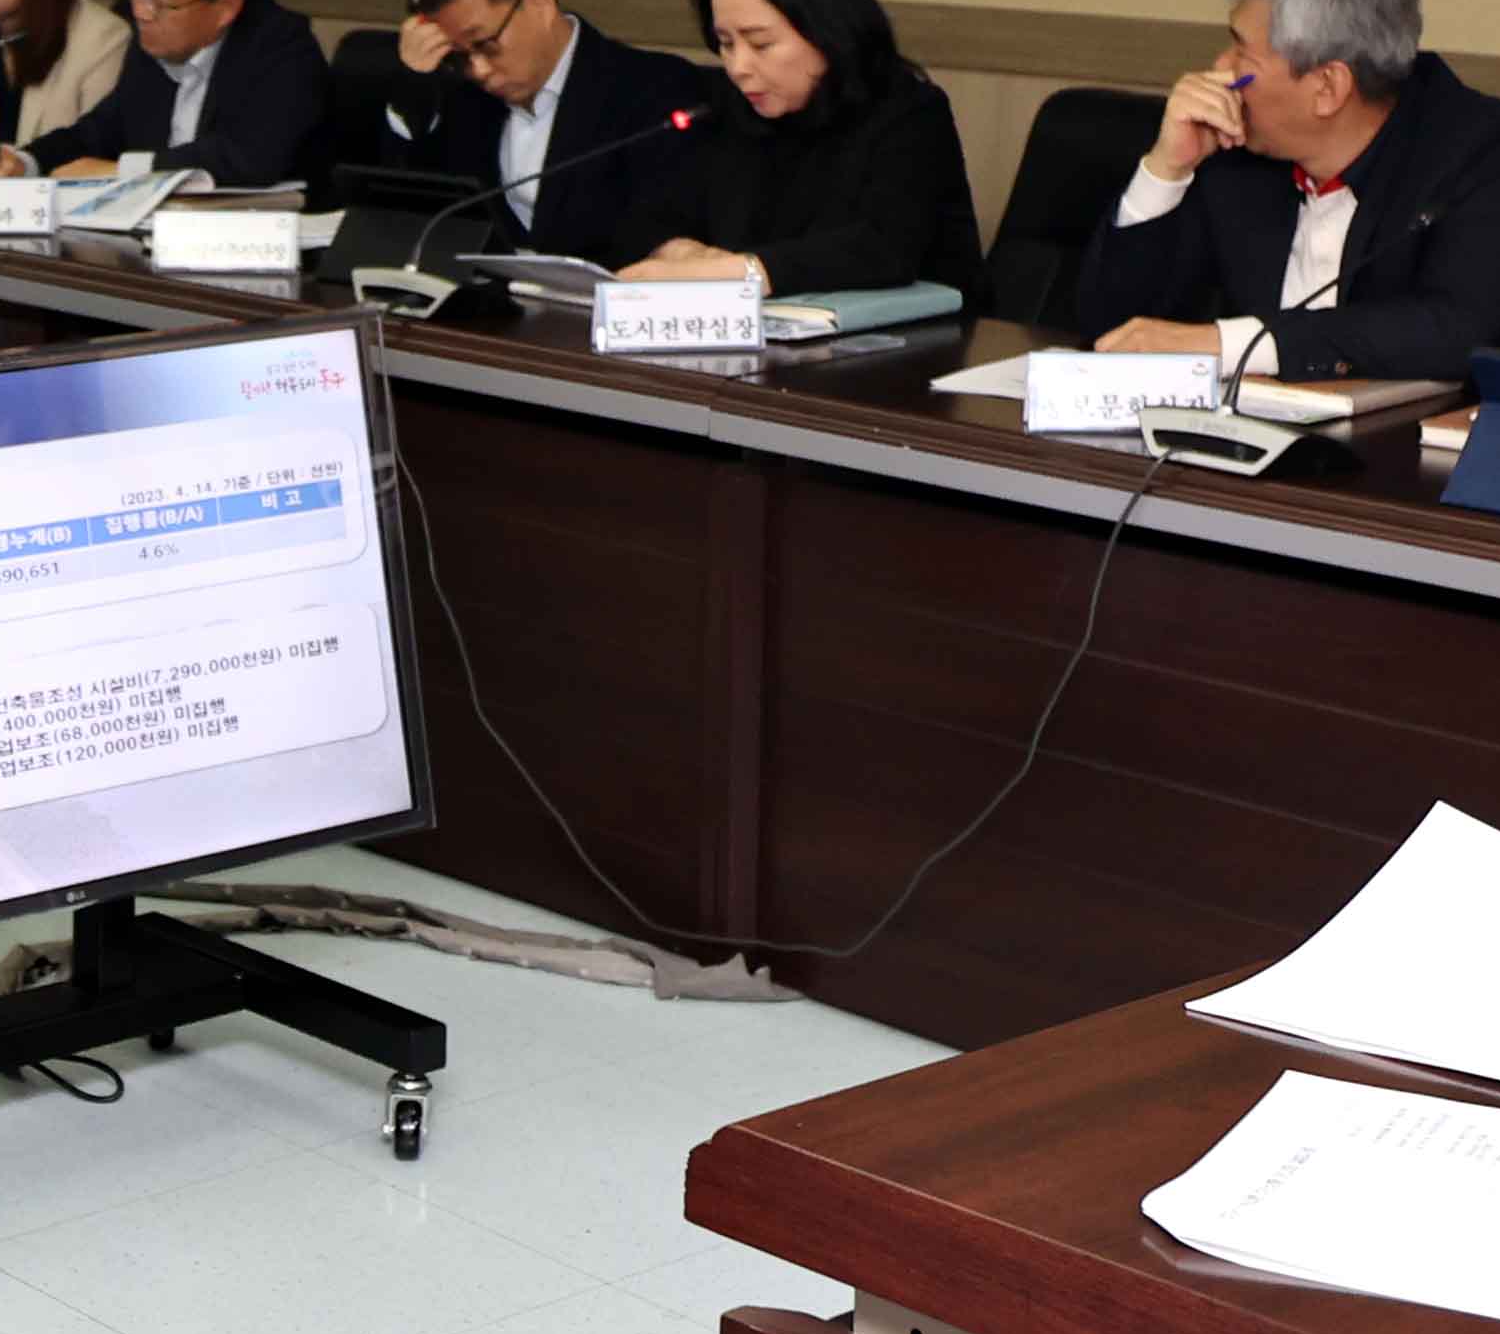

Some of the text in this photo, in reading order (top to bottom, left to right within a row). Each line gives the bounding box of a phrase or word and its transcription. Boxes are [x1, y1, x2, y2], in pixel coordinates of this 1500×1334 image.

[608, 316, 756, 342] 도시전략실장
[138, 544, 180, 562] 4.6%
[89, 645, 283, 698] 시설비(7,290,000천원)
[288, 634, 341, 659] 미집행
[128, 683, 183, 709] 미집행
[173, 696, 227, 721] 미집행
[187, 714, 240, 739] 미집행
